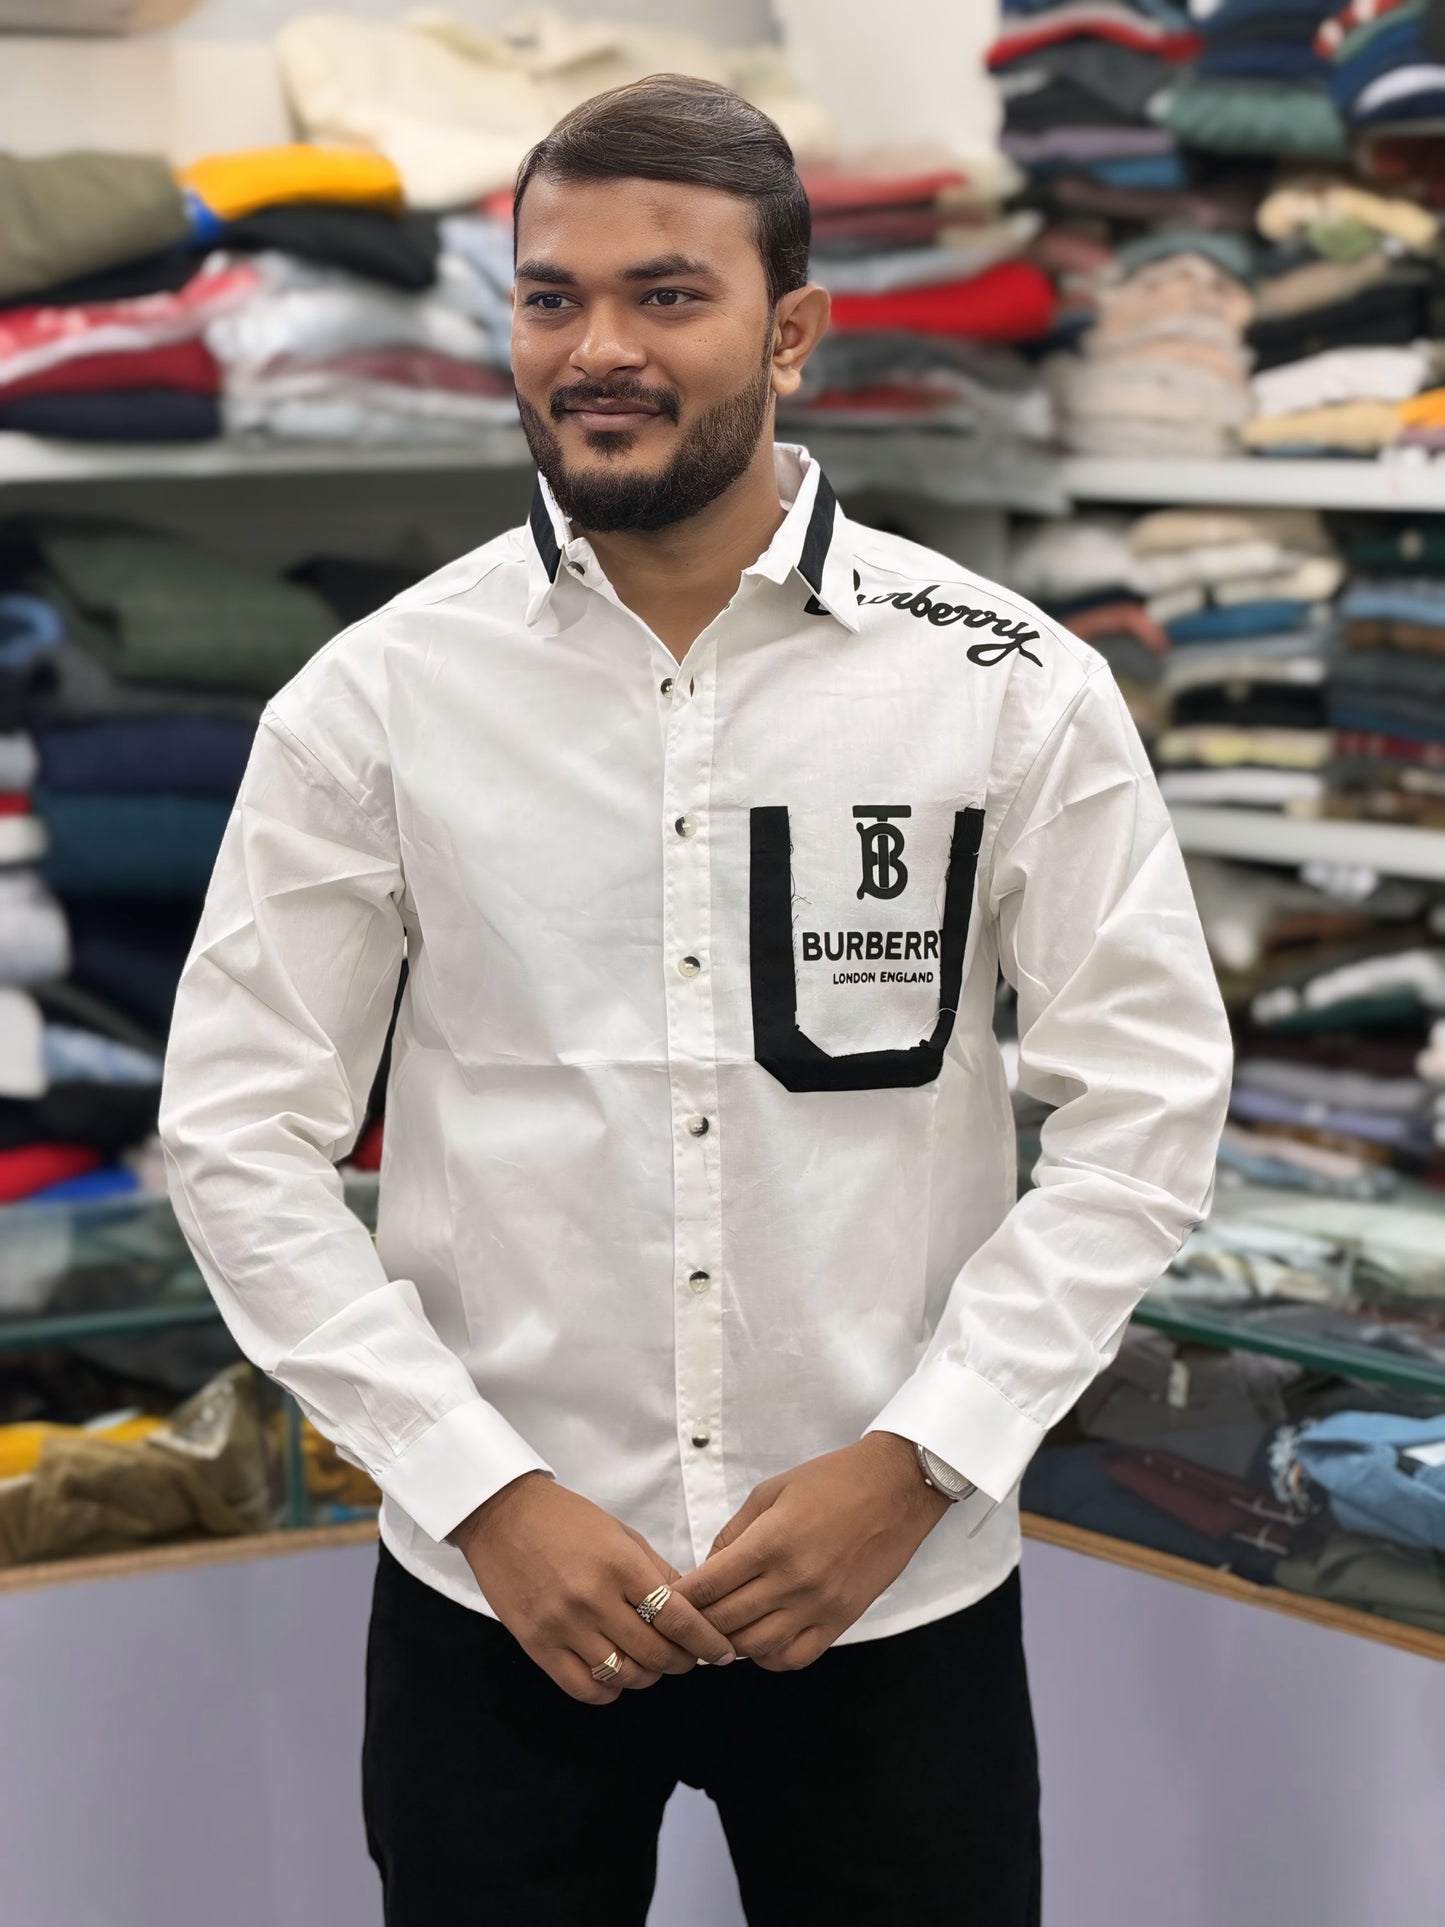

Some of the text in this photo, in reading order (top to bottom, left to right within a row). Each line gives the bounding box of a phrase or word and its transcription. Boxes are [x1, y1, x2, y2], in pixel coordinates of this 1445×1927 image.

[804, 568, 1043, 667] rberry
[802, 930, 941, 961] BURBERR
[833, 971, 934, 985] LONDON ENGLAND
